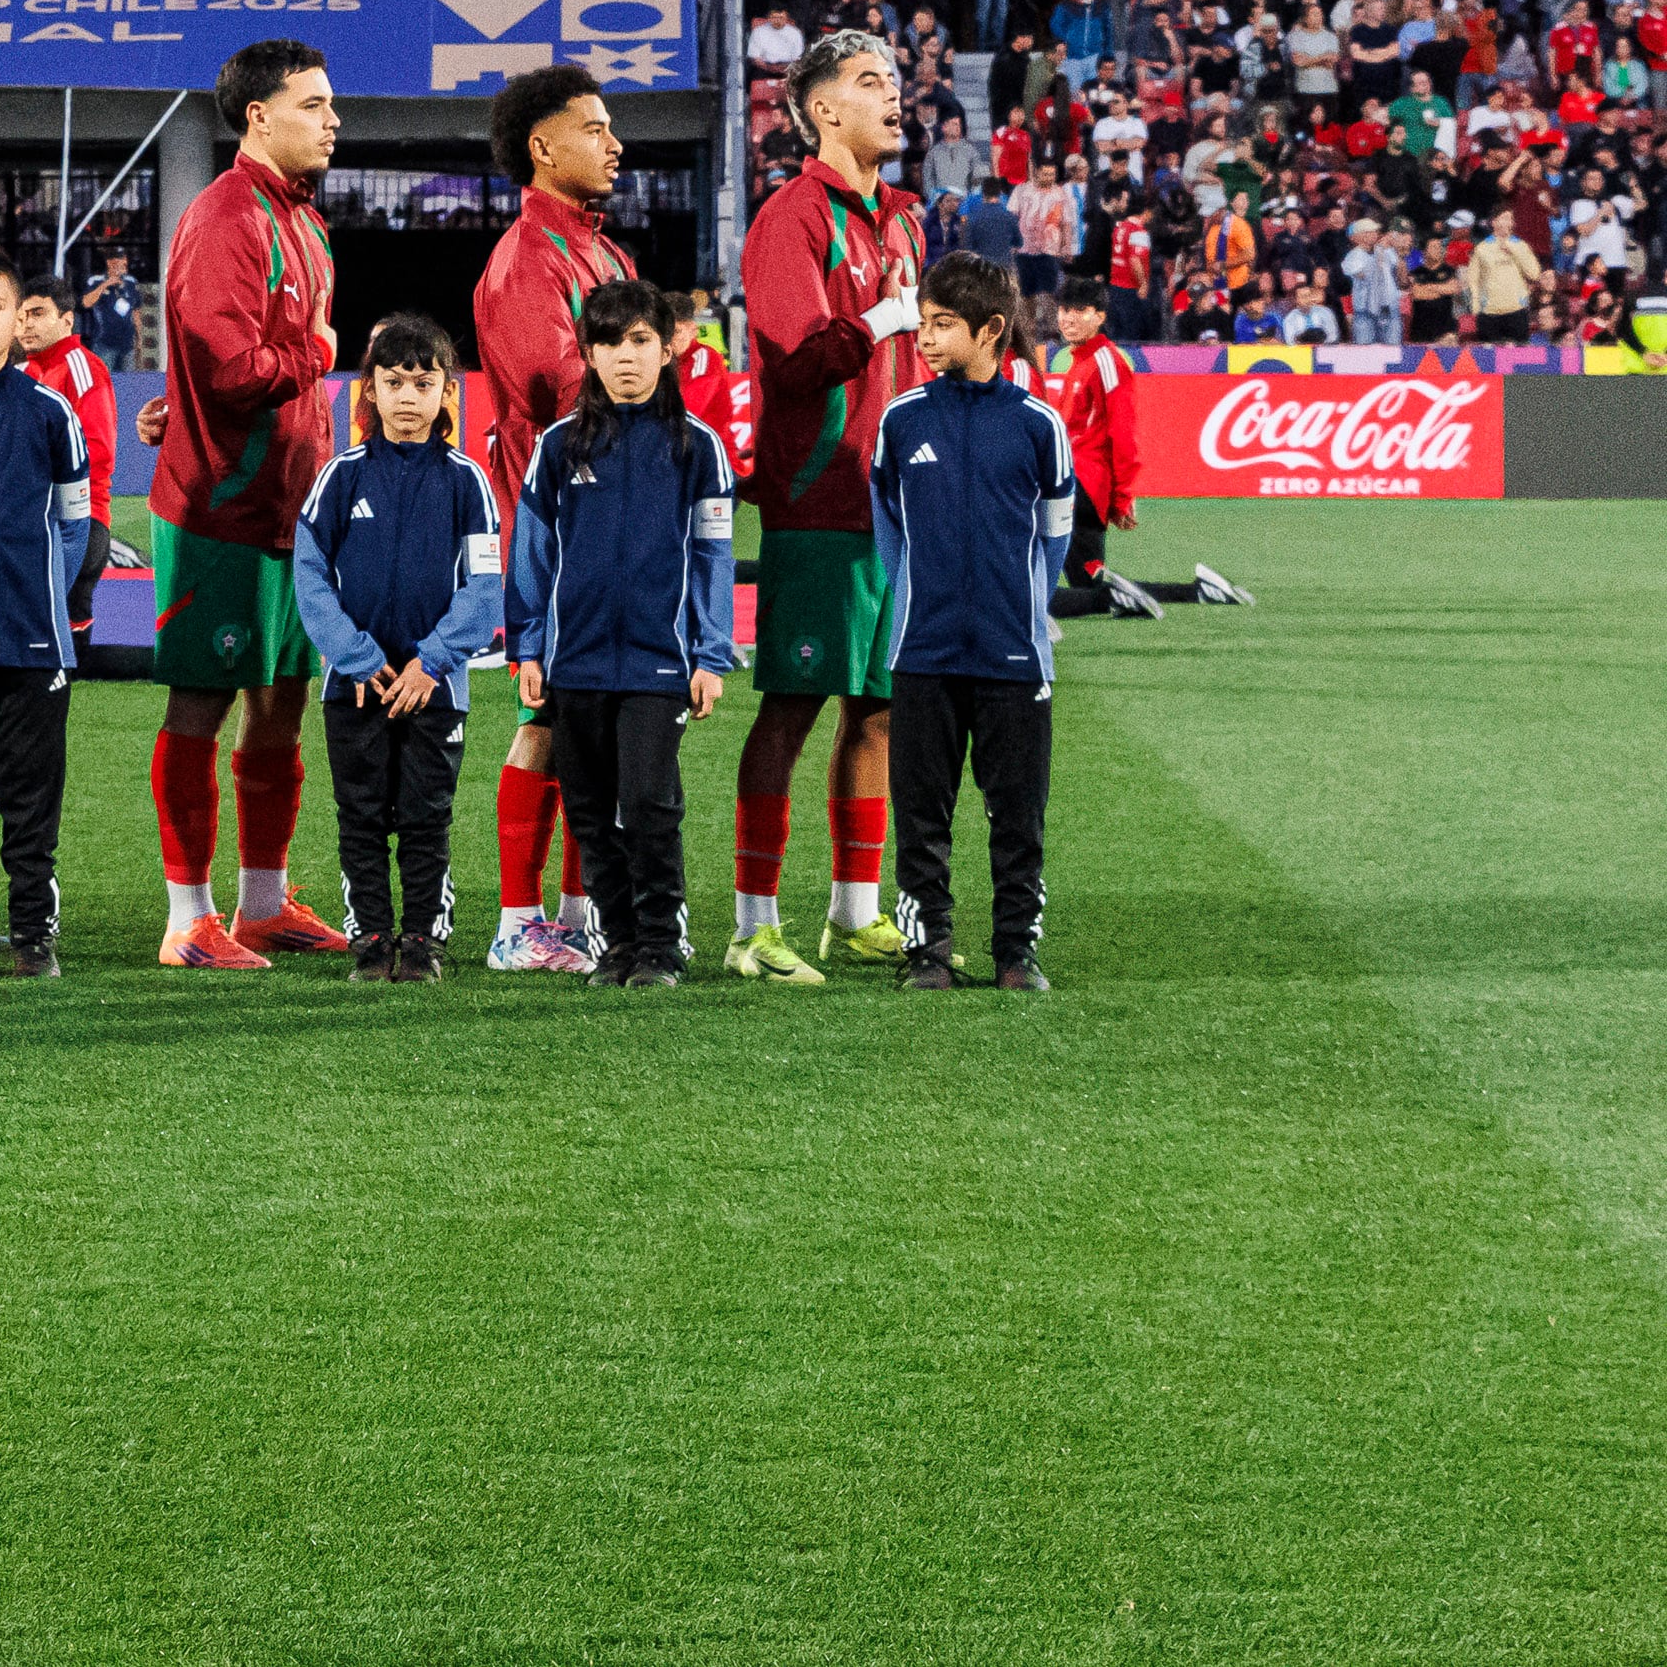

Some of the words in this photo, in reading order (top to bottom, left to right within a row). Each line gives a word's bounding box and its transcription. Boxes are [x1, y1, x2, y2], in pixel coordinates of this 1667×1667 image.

[1198, 378, 1489, 471] Coca-Cola
[1258, 477, 1321, 495] ZERO
[1326, 474, 1421, 495] AZÚCAR
